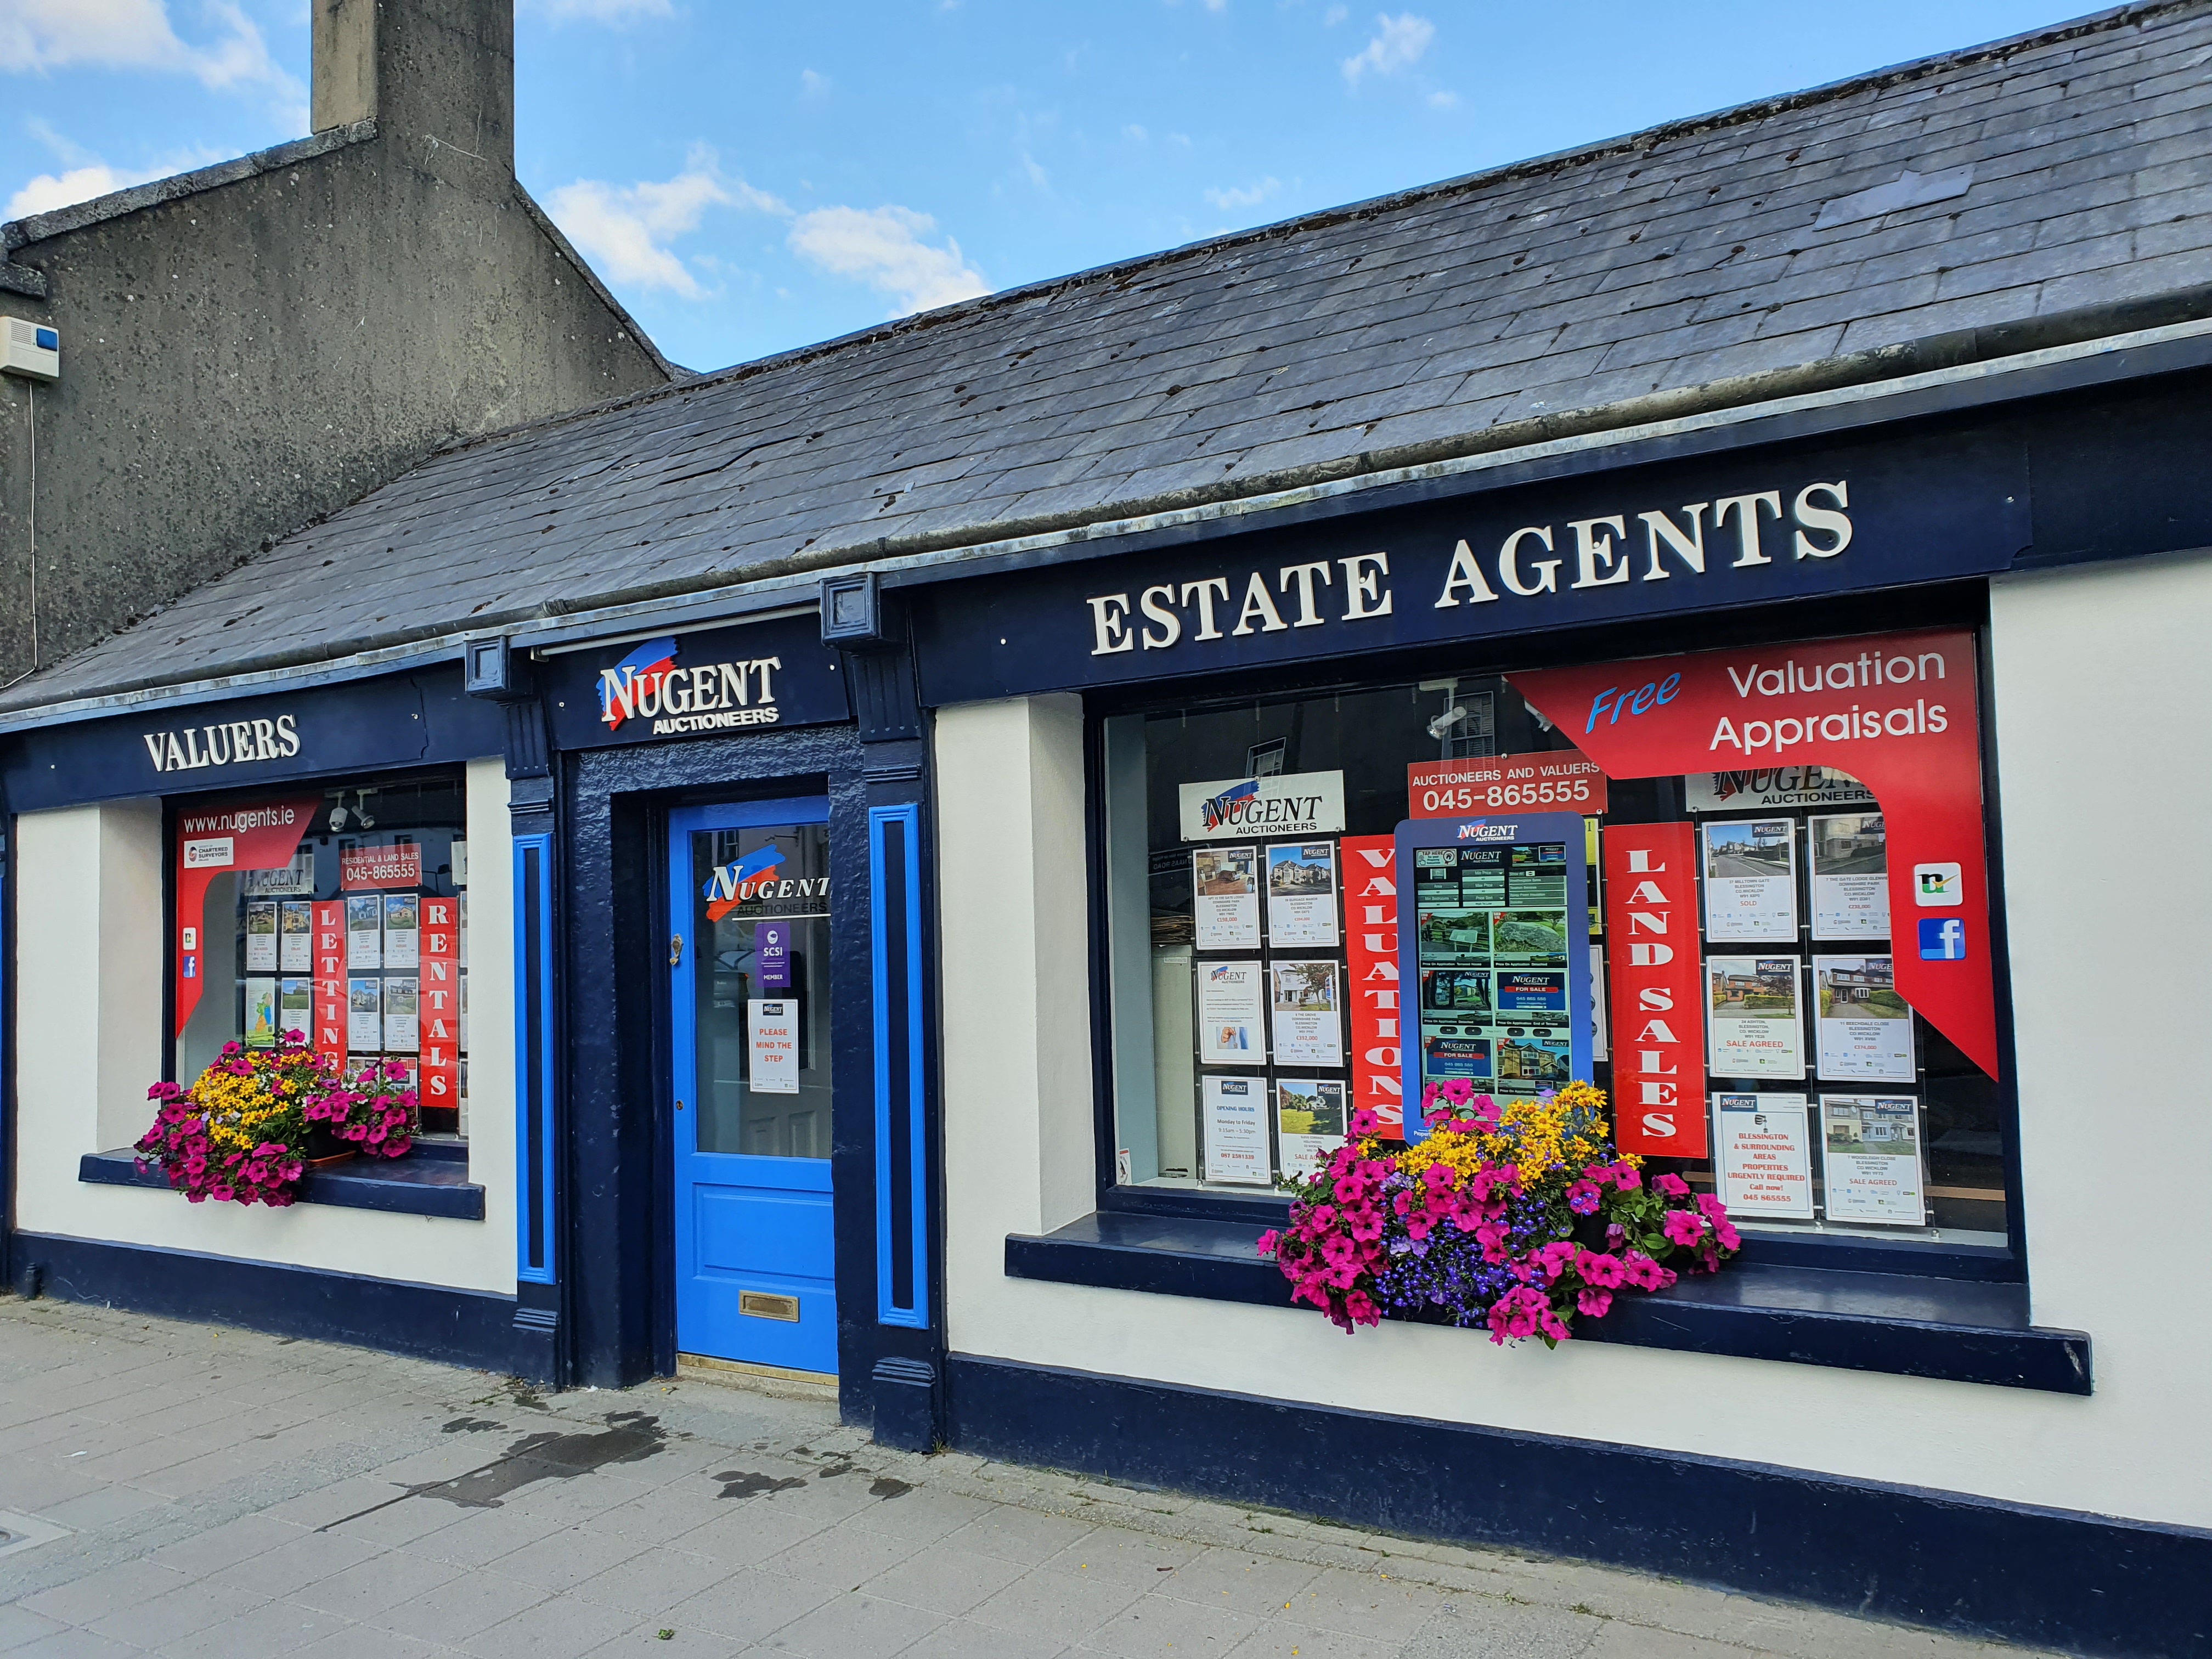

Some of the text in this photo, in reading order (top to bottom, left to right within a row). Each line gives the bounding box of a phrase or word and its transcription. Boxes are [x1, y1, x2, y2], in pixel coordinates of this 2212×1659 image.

[1087, 479, 1854, 657] ESTATE AGENTS
[1726, 651, 1946, 698] Valuation
[600, 656, 781, 723] NUGENT
[1585, 671, 1683, 735] Free
[653, 707, 779, 735] AUCTIONEERS
[1709, 698, 1948, 755] Appraisals
[144, 714, 301, 772] VALUERS
[1412, 761, 1600, 787] AUCTIONEERS AND VALUERS
[1423, 779, 1590, 811] 045-865555
[184, 805, 295, 833] www.nugents.ie
[1202, 795, 1323, 827] NUGENT
[1235, 822, 1317, 835] AUCTIONEERS
[1457, 824, 1518, 839] NUGENT
[341, 854, 376, 865] RESIDENTIAL
[384, 853, 399, 862] LAND
[401, 851, 419, 861] SALES
[1303, 848, 1329, 856] NUGENT
[1461, 851, 1502, 860] NUGENT
[346, 863, 415, 882] 045-865555
[706, 865, 830, 902] NUGENT
[737, 901, 828, 916] AUCTIONEERS
[763, 946, 783, 957] SCSI
[1210, 970, 1247, 980] NUGENT
[1757, 962, 1793, 971] NUGENT
[1867, 962, 1892, 970] NUGE
[320, 909, 341, 1070] LETTING
[1624, 849, 1681, 1138] LAND SALES
[428, 904, 449, 1096] RENTALS
[1440, 1042, 1476, 1050] NUGENT
[1318, 1085, 1341, 1094] NUGENT
[1722, 1098, 1756, 1106] NUGENT
[1877, 1102, 1911, 1111] NUGENT
[1767, 1173, 1805, 1182] REQUIRED
